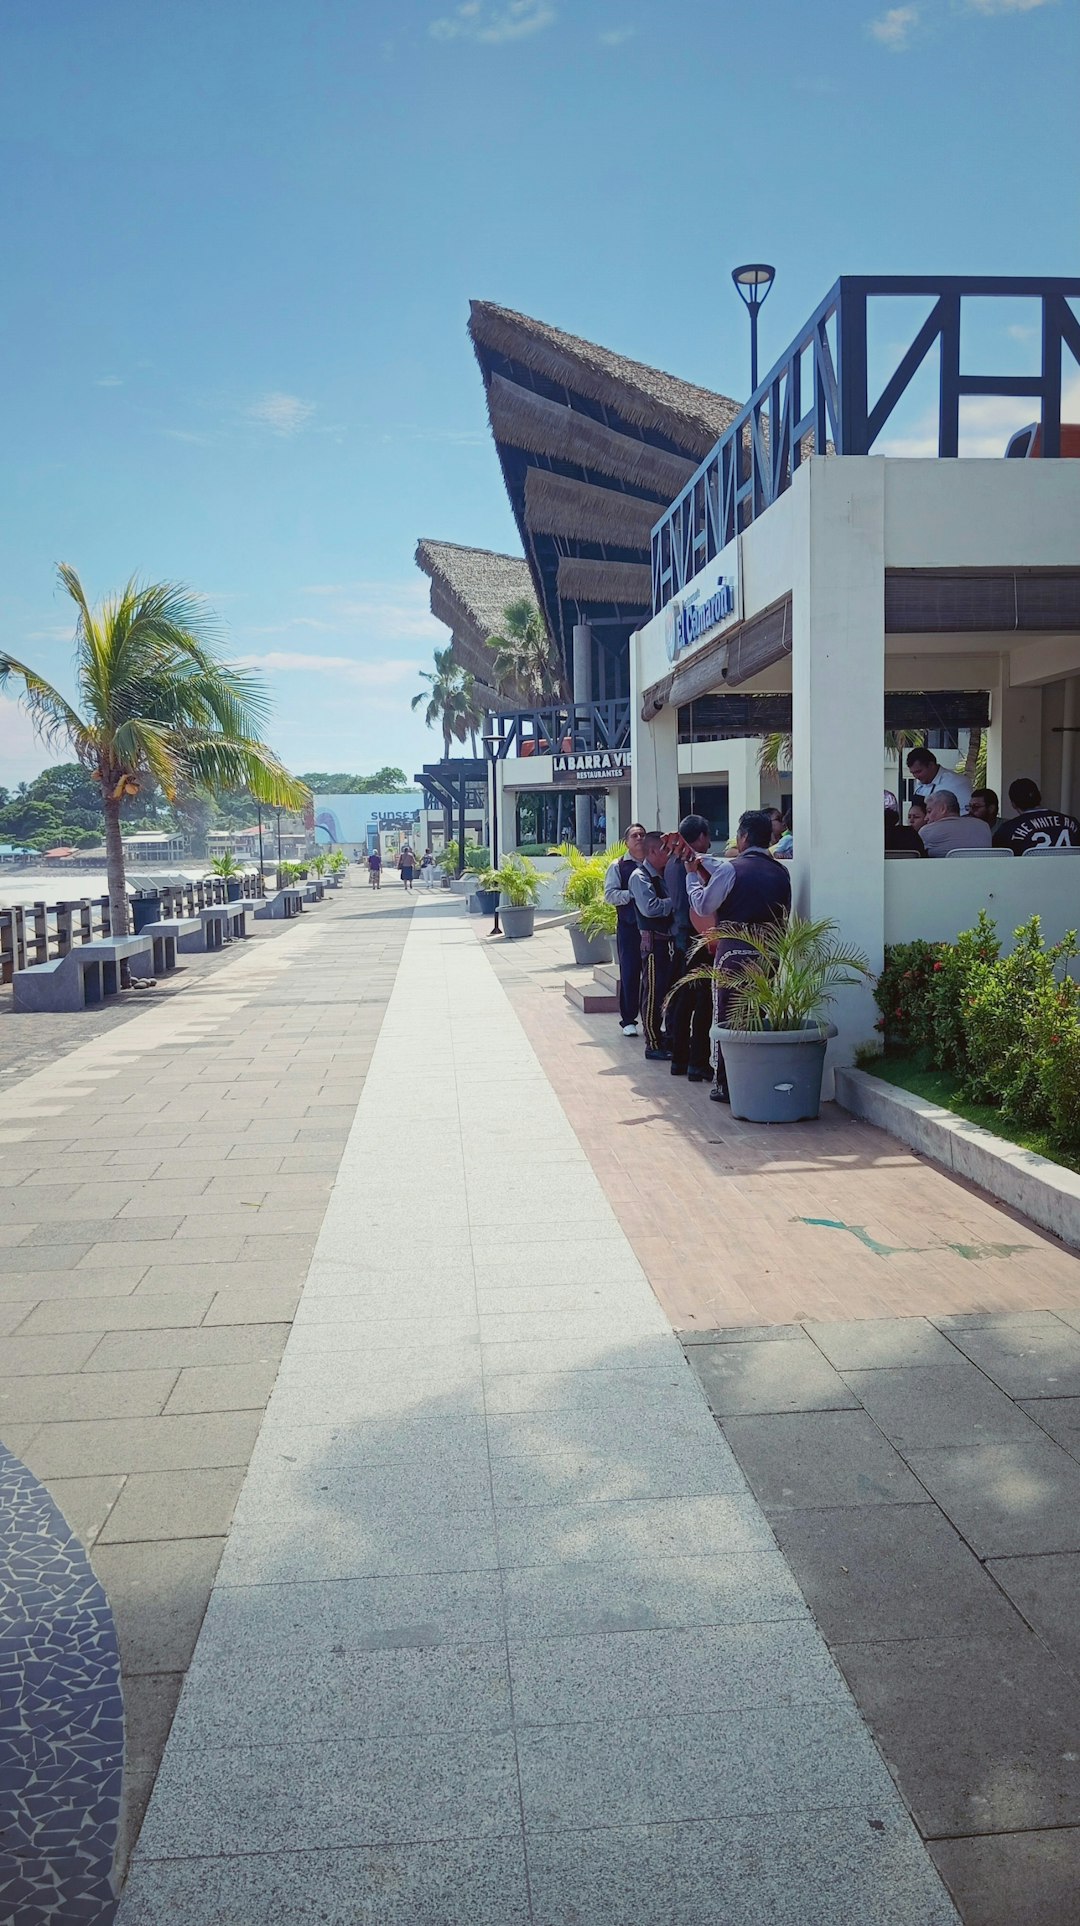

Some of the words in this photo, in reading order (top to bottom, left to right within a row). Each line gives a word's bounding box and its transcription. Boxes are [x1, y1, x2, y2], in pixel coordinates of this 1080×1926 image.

[553, 756, 566, 771] LA
[567, 754, 612, 770] BARRA
[576, 769, 623, 779] RESTAURANTES
[1011, 822, 1033, 841] THE
[1030, 815, 1061, 830] WHITE
[1031, 828, 1072, 848] 24
